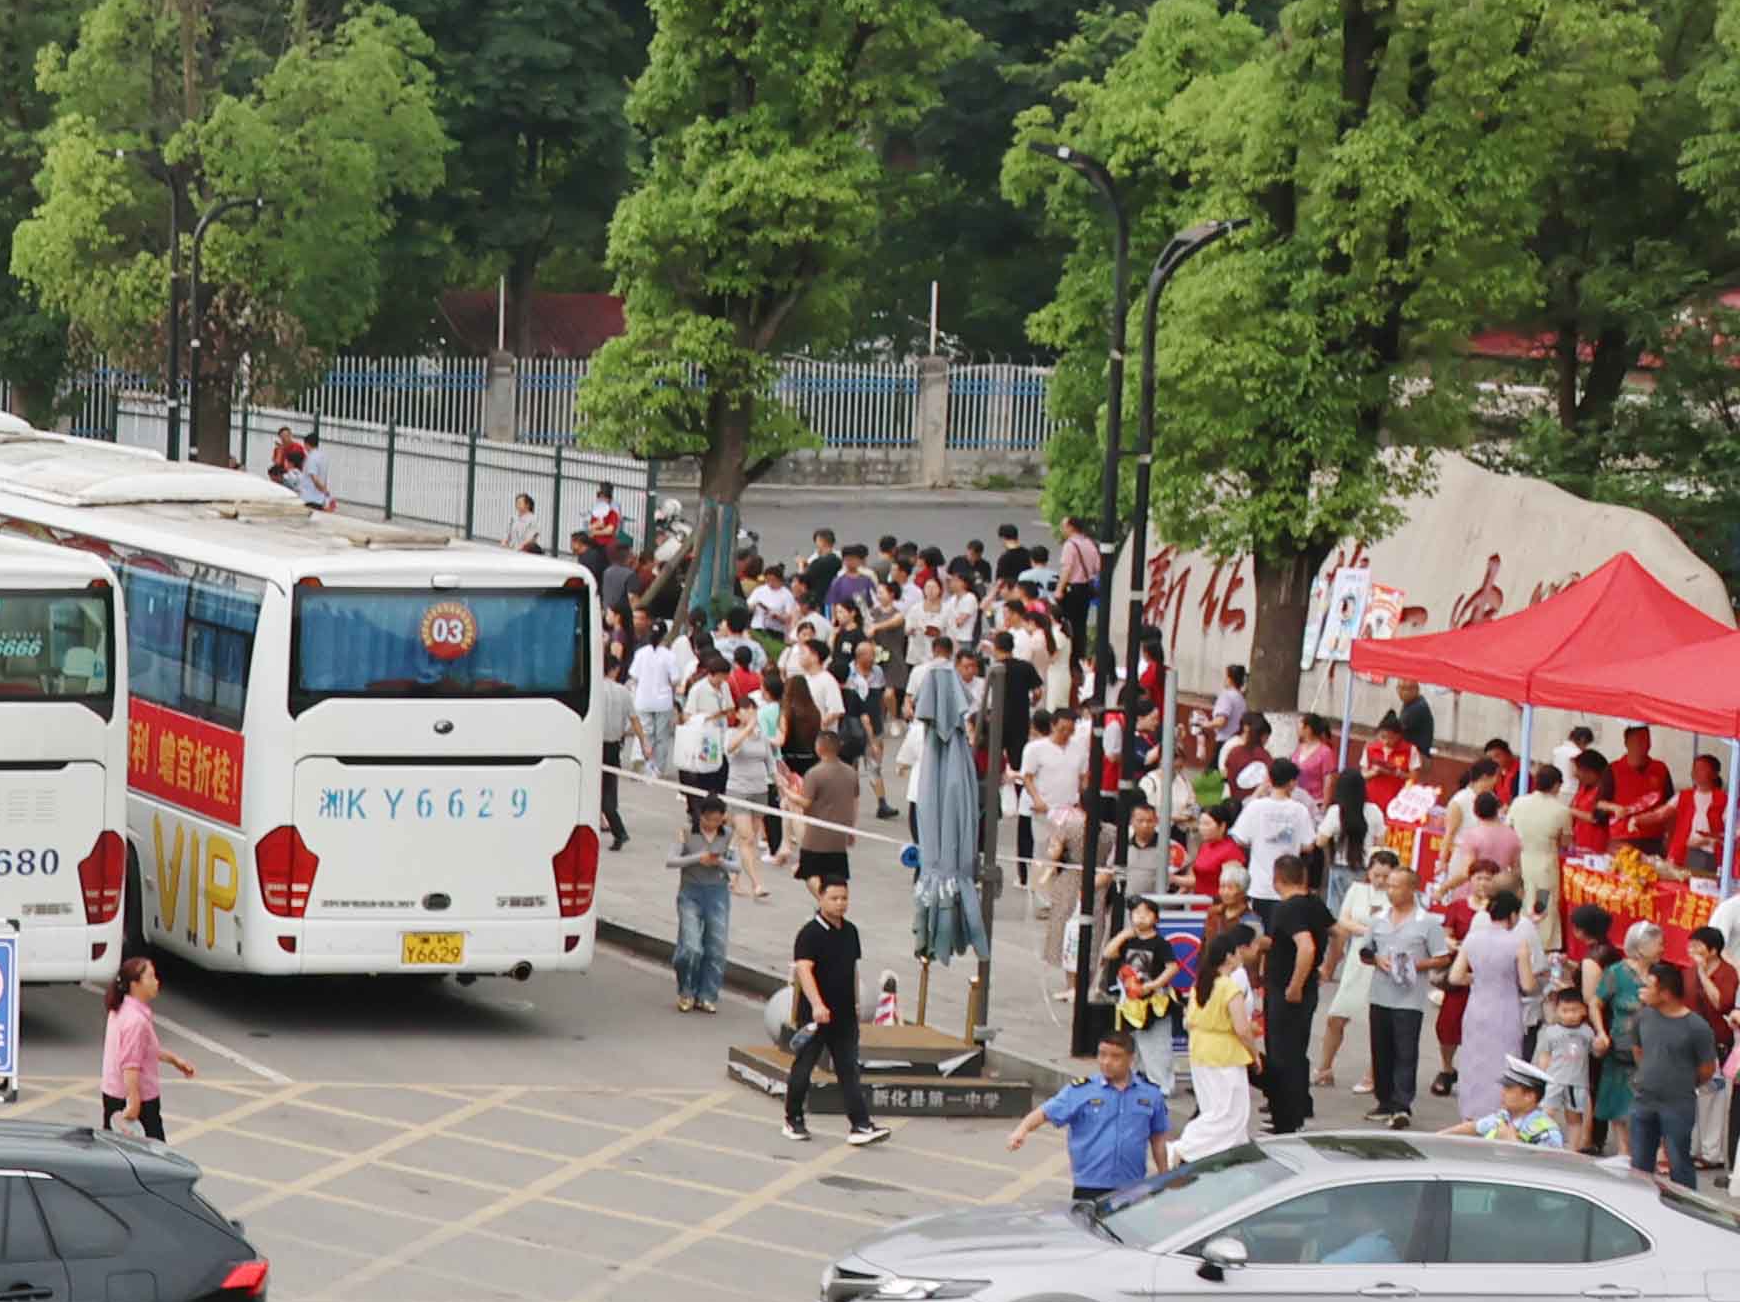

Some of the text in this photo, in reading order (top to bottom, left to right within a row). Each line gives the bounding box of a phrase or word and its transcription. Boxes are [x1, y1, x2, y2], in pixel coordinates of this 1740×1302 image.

[432, 616, 465, 646] 03
[152, 811, 241, 951] VIP
[406, 946, 461, 964] Y6629
[871, 1088, 1000, 1110] 新化县第一中学
